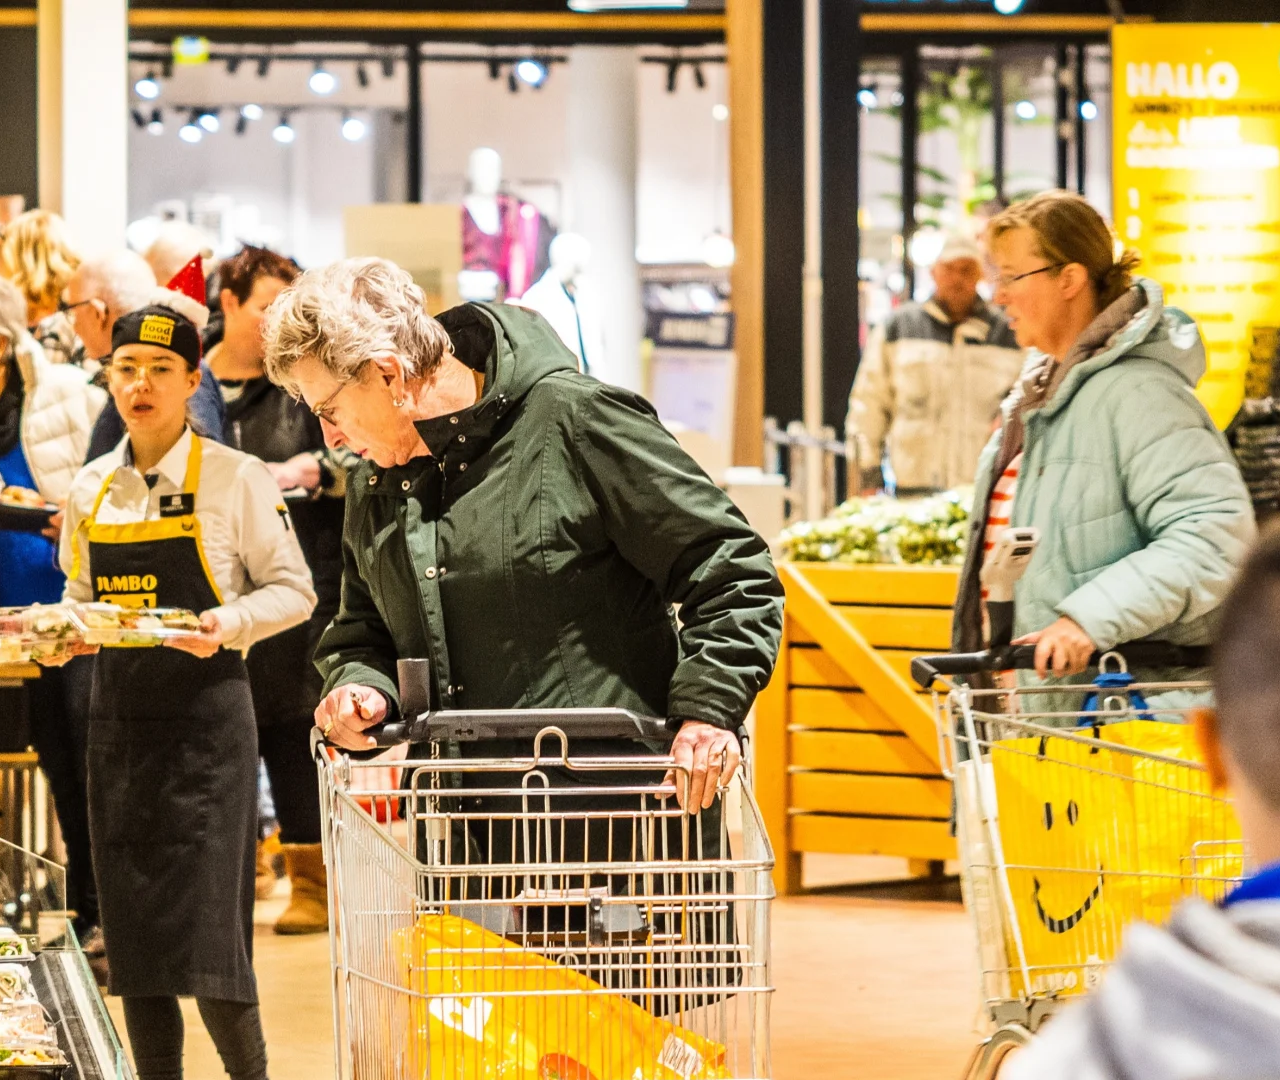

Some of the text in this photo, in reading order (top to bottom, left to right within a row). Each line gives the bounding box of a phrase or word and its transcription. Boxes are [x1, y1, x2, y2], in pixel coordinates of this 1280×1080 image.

[1126, 61, 1240, 99] HALLO
[144, 323, 171, 336] food
[96, 574, 158, 592] JUMBO
